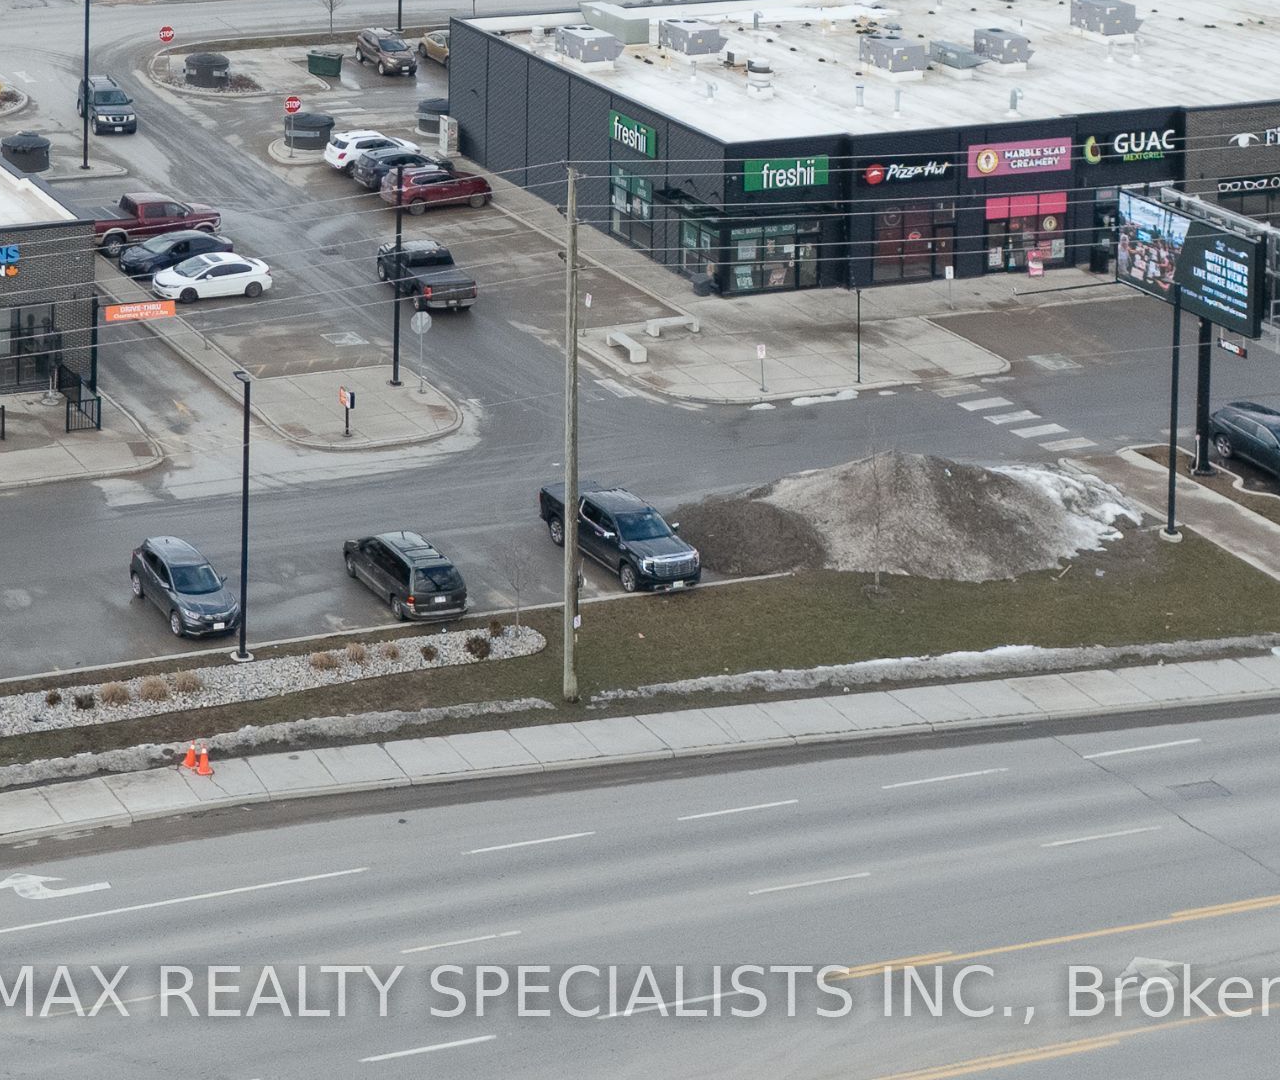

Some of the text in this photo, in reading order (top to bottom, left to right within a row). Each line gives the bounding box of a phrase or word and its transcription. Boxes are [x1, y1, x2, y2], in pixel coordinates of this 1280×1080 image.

[160, 30, 174, 38] STOP
[285, 100, 300, 108] STOP
[614, 116, 646, 153] freshii
[1114, 129, 1175, 153] GUAC
[1005, 146, 1066, 159] MARBLE SLAB
[1011, 157, 1060, 168] CREAMERY
[762, 159, 815, 188] freshii
[886, 161, 949, 181] Pizza Hut
